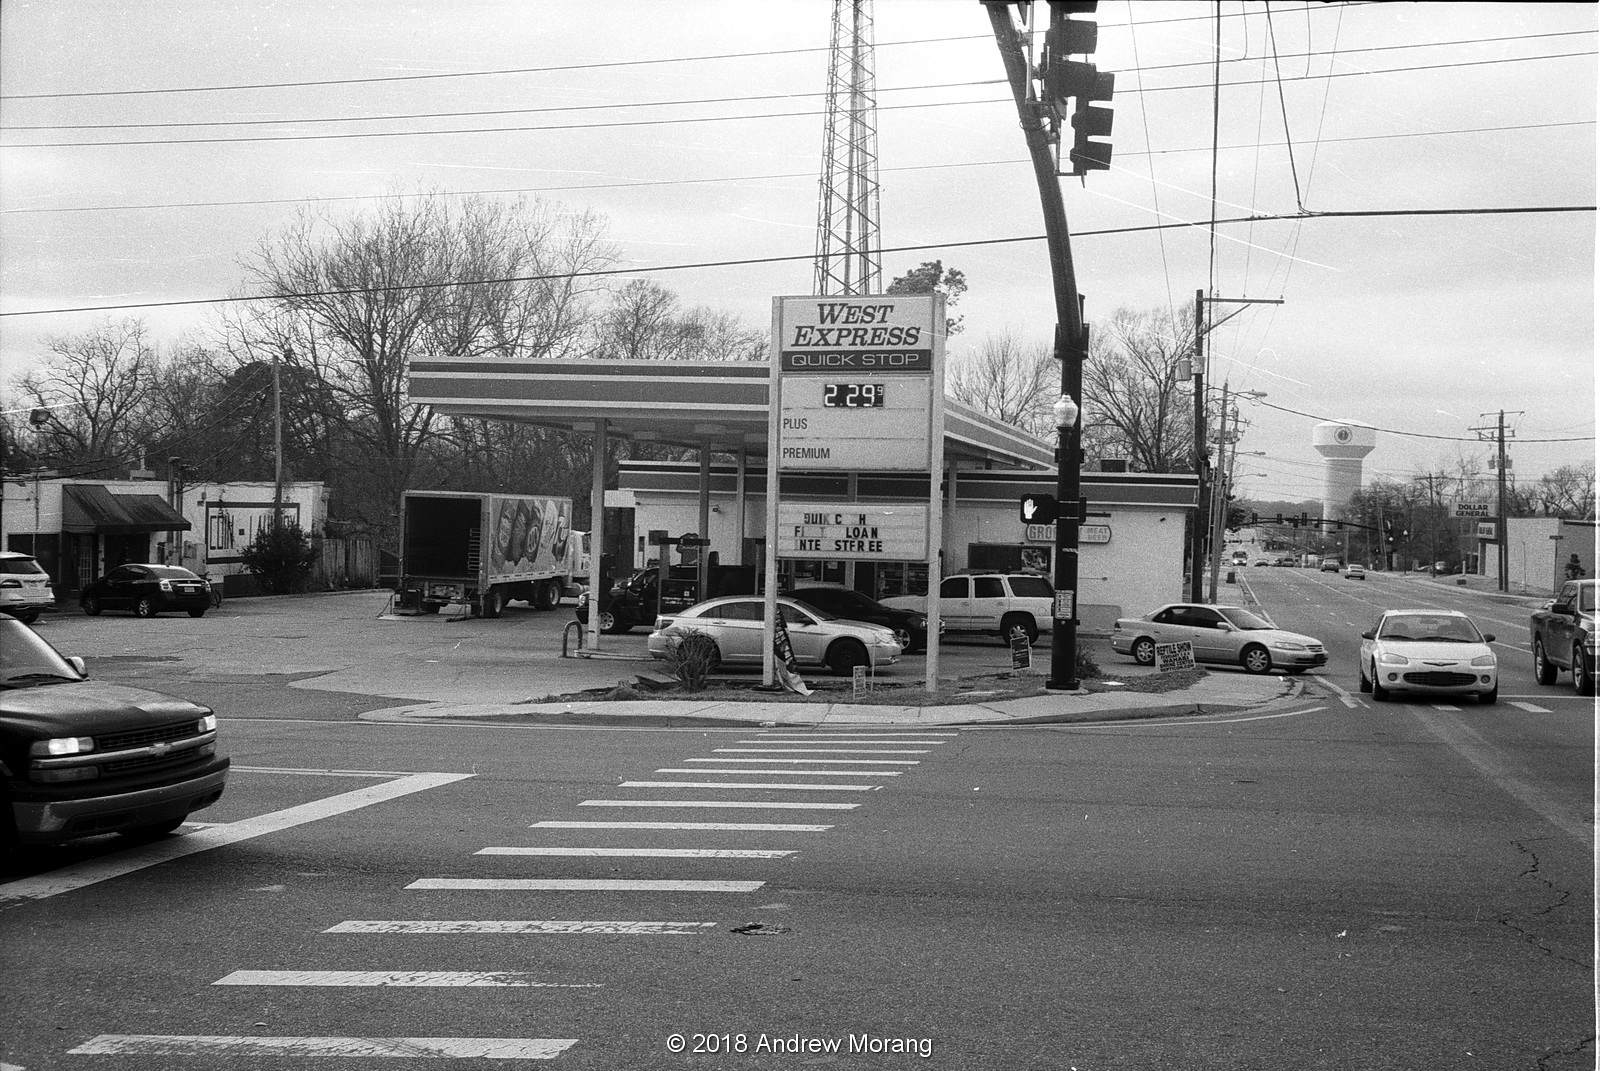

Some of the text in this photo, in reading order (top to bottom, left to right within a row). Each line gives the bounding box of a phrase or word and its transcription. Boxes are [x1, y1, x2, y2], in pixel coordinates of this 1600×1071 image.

[817, 303, 895, 325] WEST
[791, 326, 921, 347] EXPRESS
[791, 353, 919, 366] QUICK STOP
[783, 418, 808, 430] PLUS
[782, 447, 830, 459] PREMIUM
[846, 527, 878, 539] LOAN
